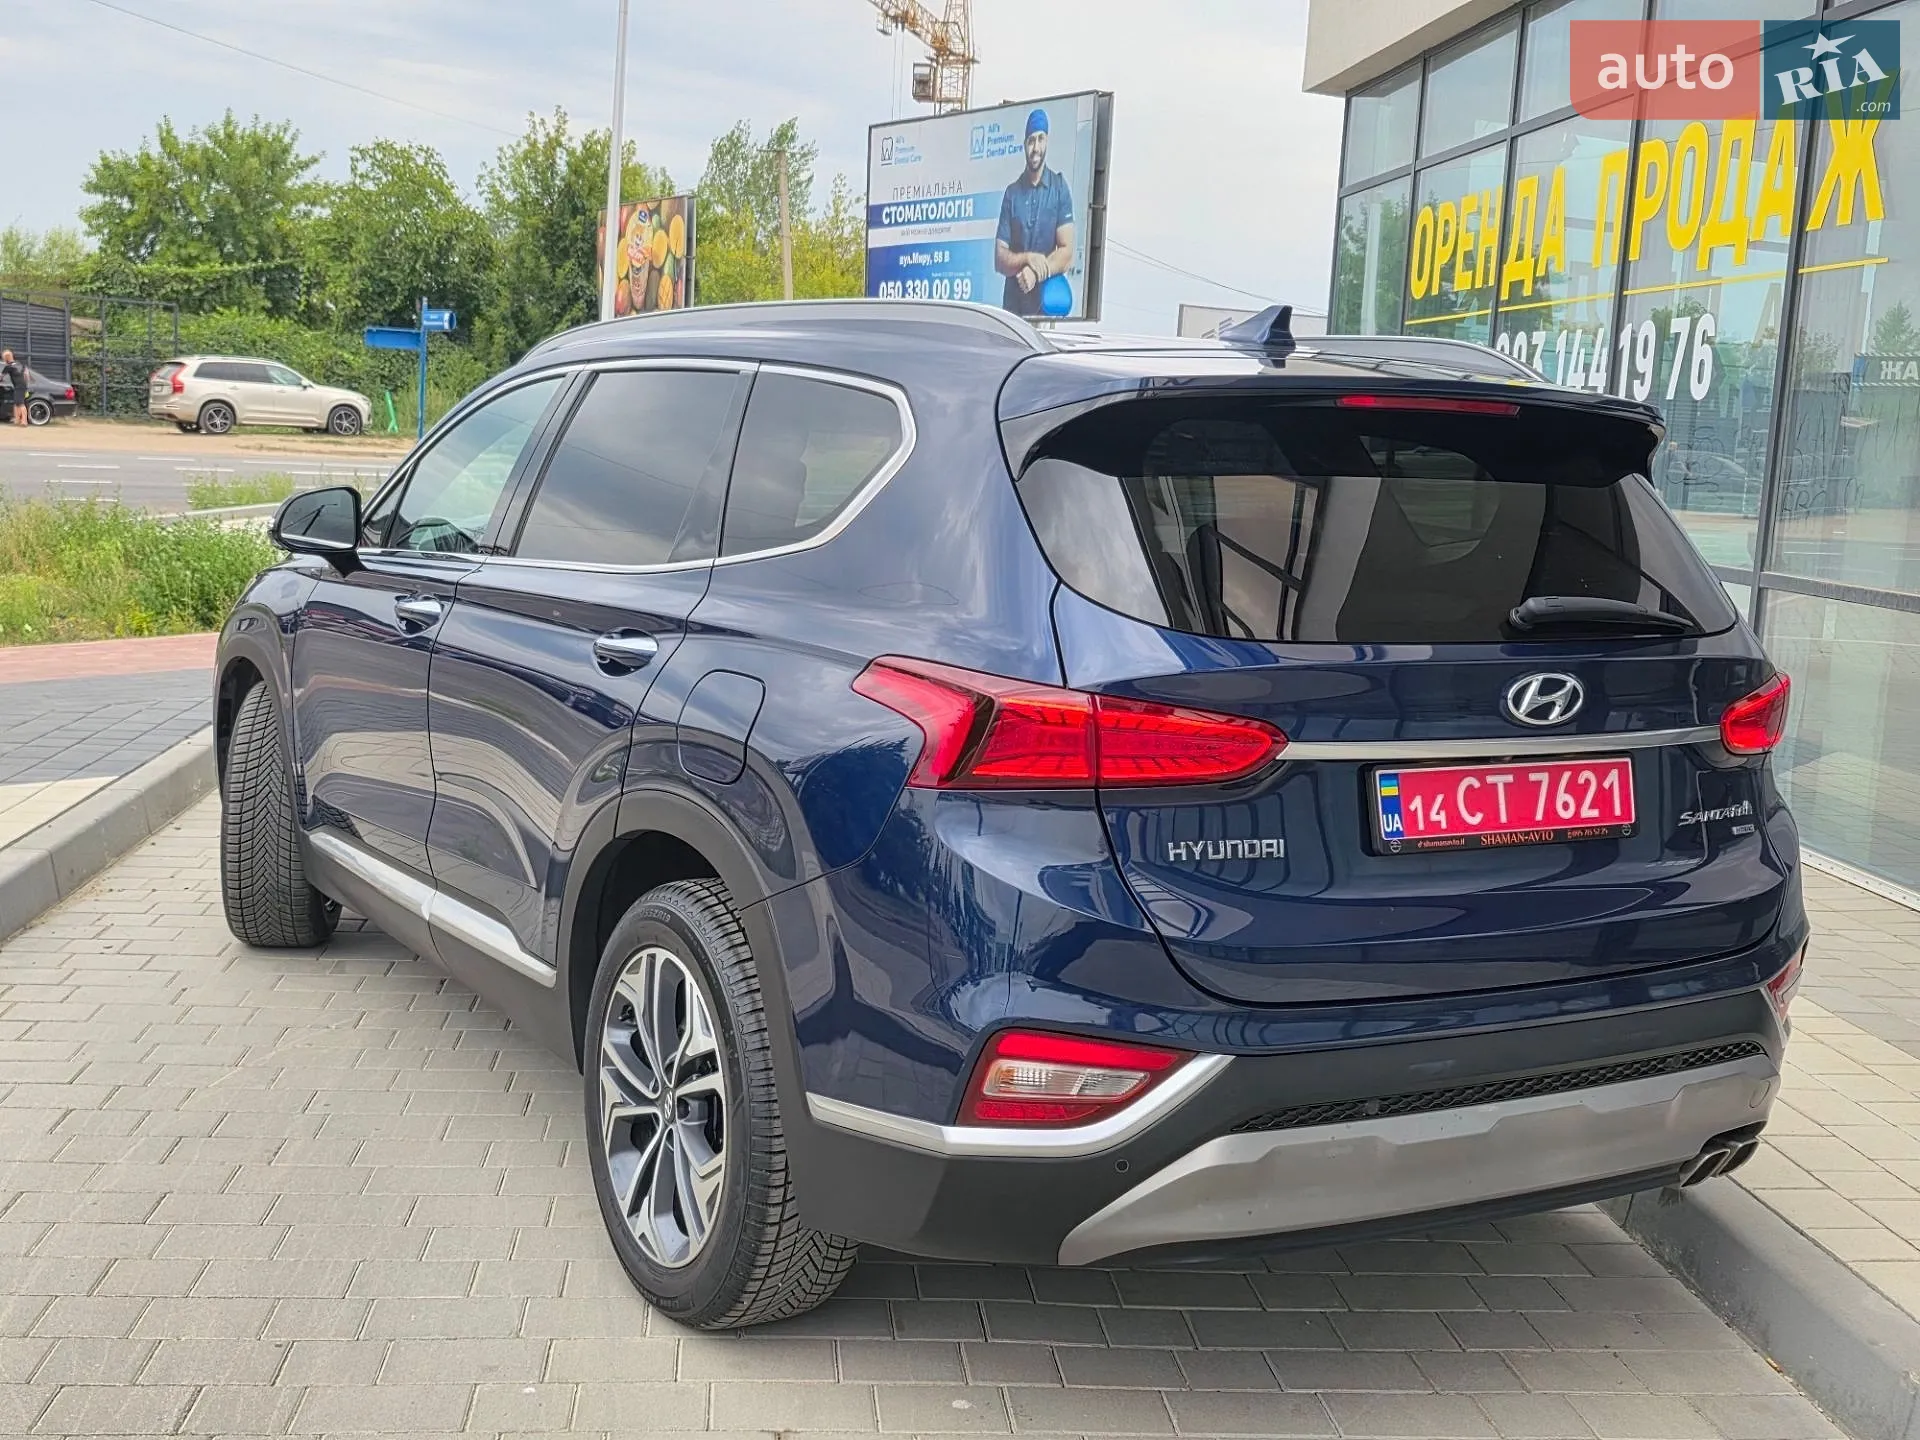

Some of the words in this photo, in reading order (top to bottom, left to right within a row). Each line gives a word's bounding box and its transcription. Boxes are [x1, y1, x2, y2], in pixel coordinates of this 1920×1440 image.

[987, 144, 1007, 158] Dental
[1008, 144, 1023, 154] Care
[892, 180, 963, 200] ПРЕМІАЛЬНА
[1410, 164, 1565, 301] ОРЕНДА
[1591, 67, 1902, 272] ПРОДАЖ
[882, 198, 974, 225] СТОМАТОЛОГІЯ
[879, 280, 903, 300] 050
[905, 279, 930, 300] 330
[932, 278, 951, 300] 00
[953, 277, 972, 300] 99
[1555, 327, 1609, 394] 144
[1618, 320, 1656, 401] 19
[1665, 313, 1716, 401] 76
[1408, 793, 1448, 831] 14
[1456, 774, 1514, 826] CT
[1528, 768, 1622, 821] 7621
[1383, 813, 1404, 832] UA
[1167, 838, 1285, 861] HYUNDAI
[1480, 830, 1554, 846] SHAMAN-AVTO
